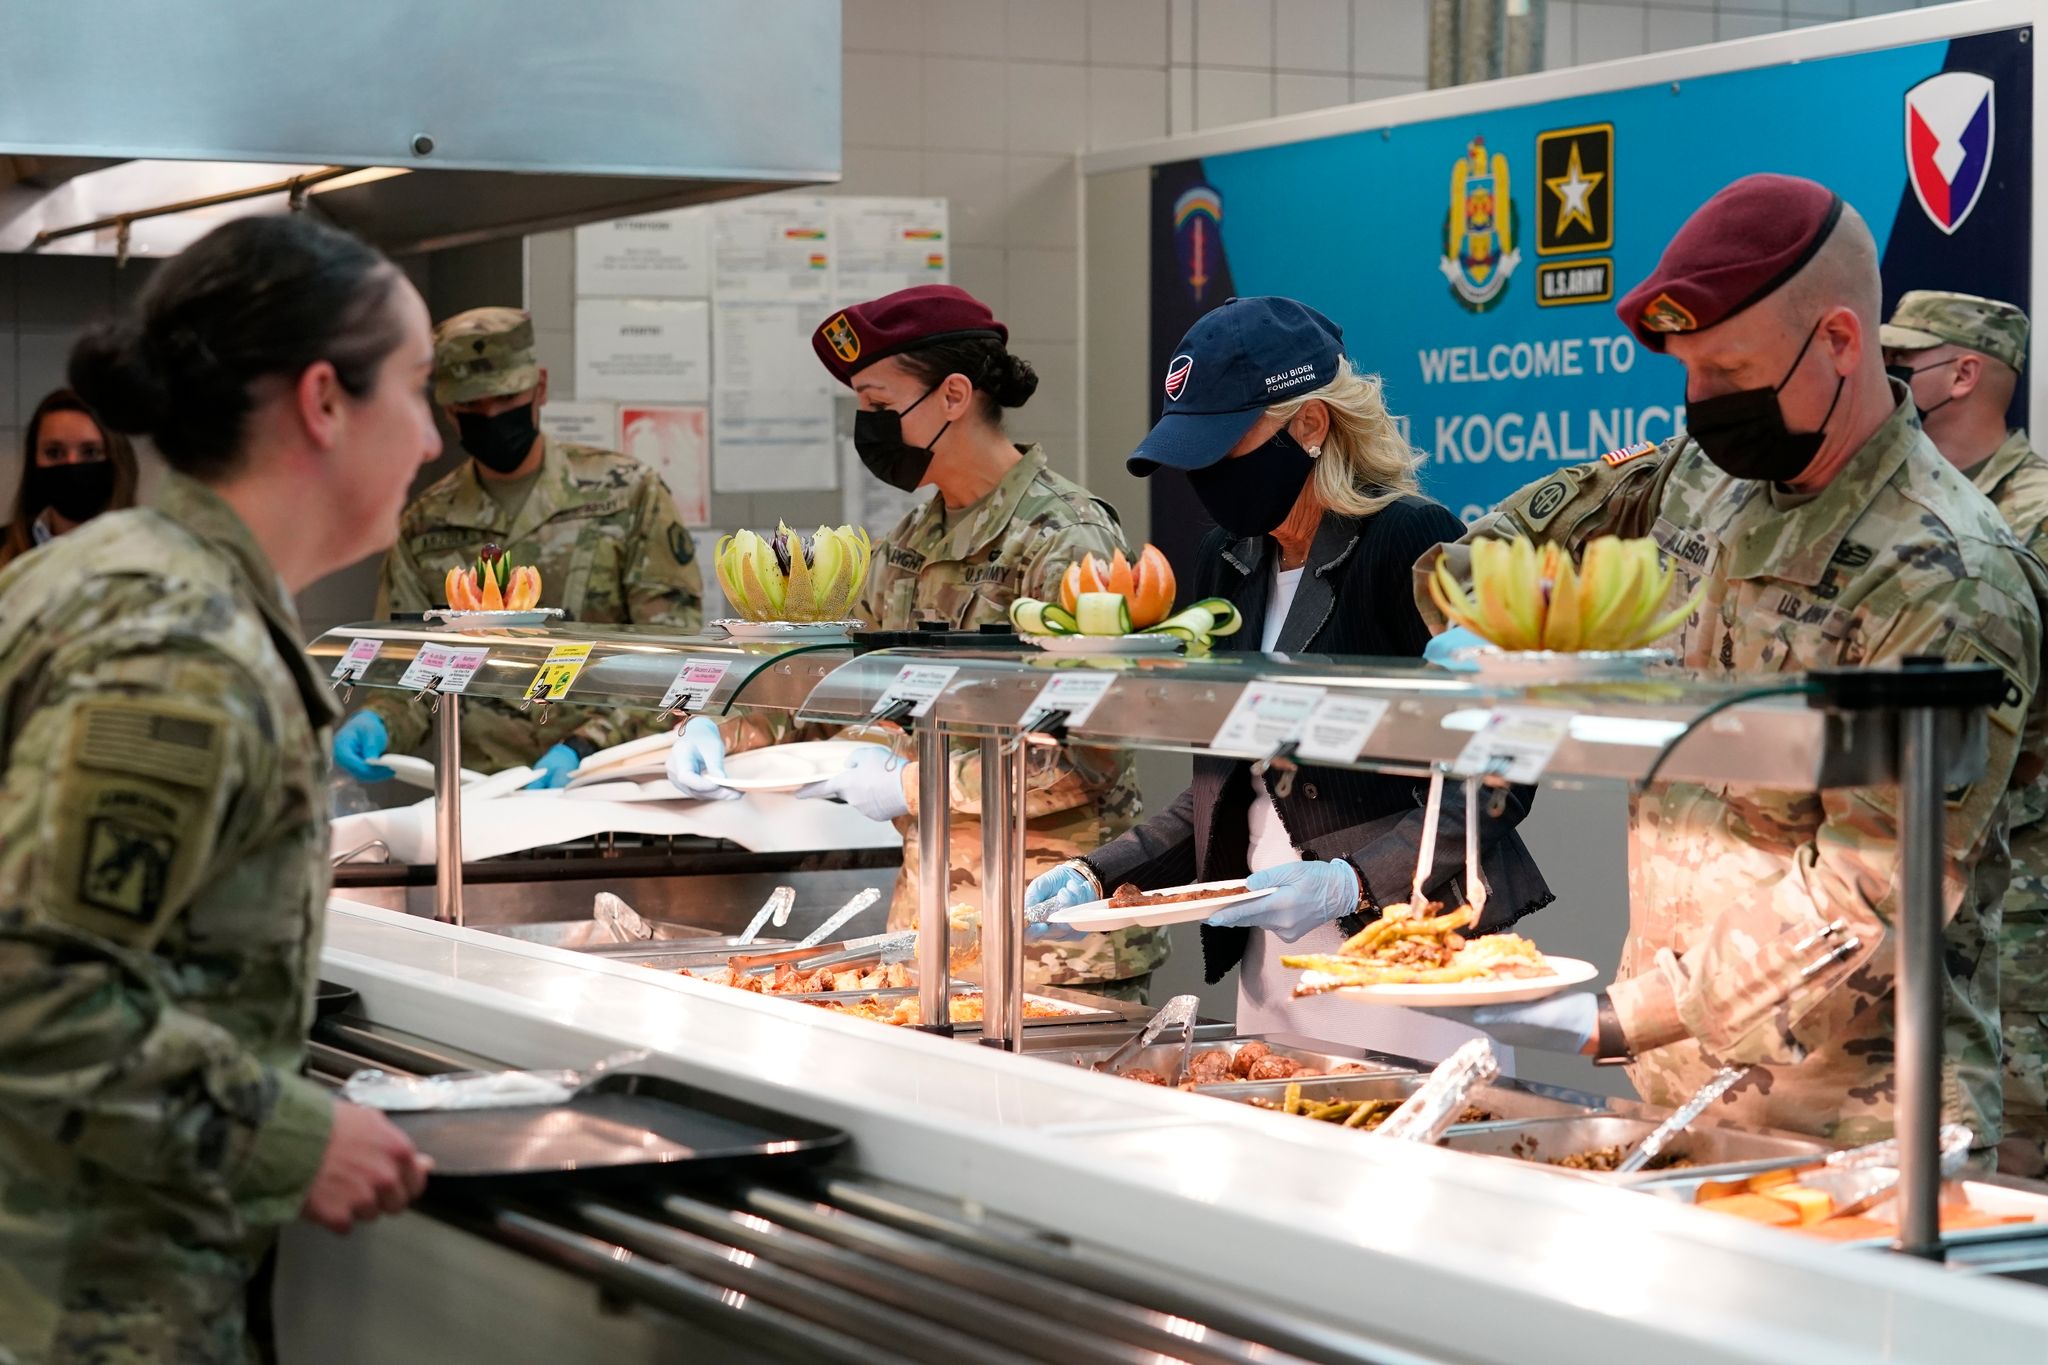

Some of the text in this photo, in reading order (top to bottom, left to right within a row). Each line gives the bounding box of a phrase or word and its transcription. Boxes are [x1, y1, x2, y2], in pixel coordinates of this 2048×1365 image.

[1418, 335, 1636, 384] WELCOME TO
[1265, 364, 1314, 386] BEAU BIDEN
[1267, 372, 1316, 393] FOUNDATION
